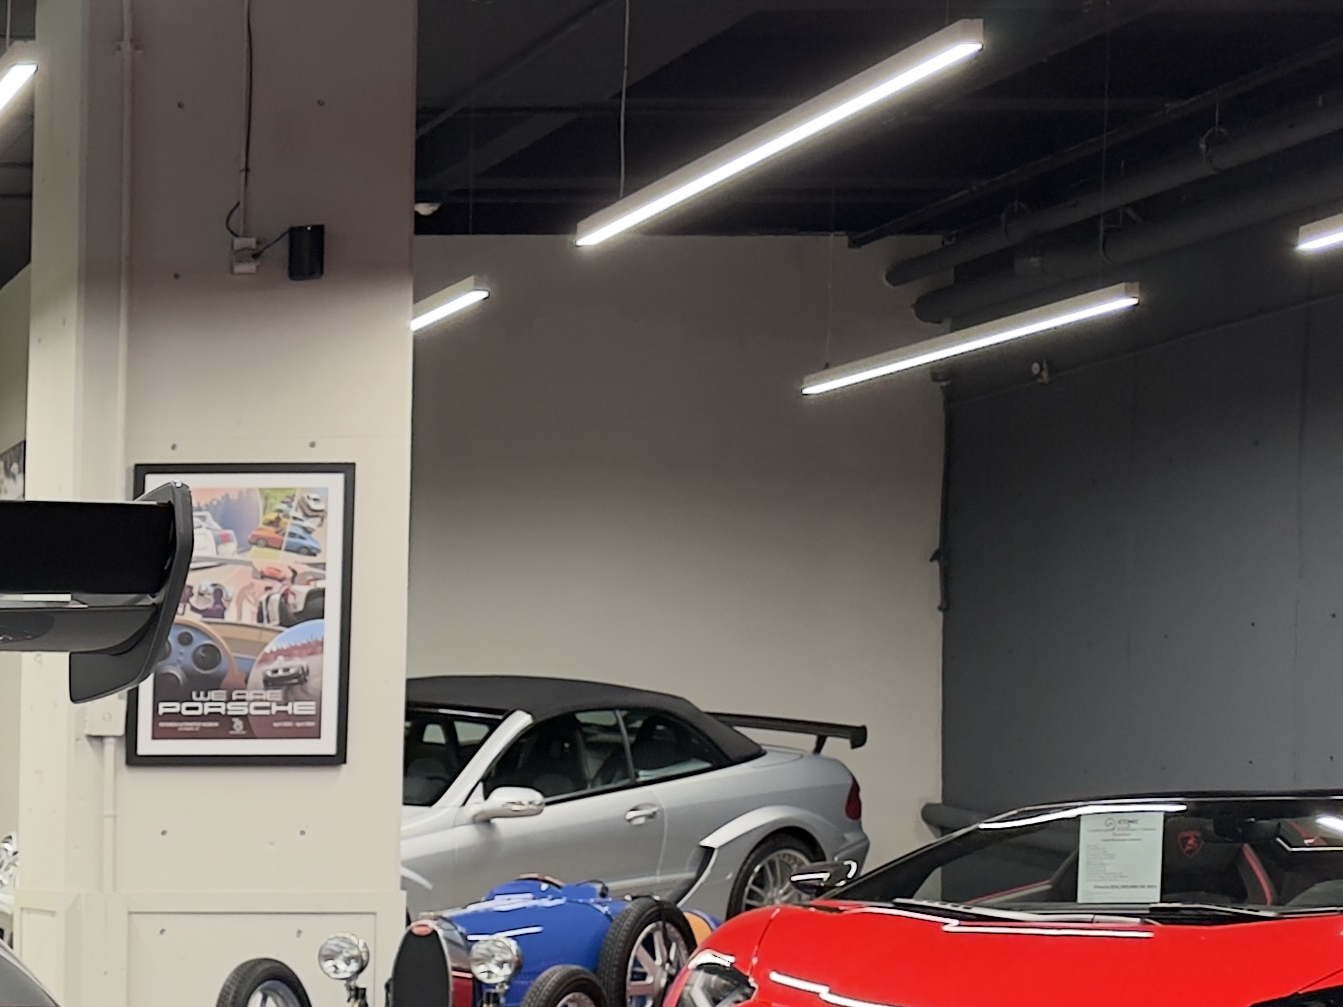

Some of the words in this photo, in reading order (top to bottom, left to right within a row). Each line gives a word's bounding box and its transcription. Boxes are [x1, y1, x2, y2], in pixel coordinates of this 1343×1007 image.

[192, 690, 227, 701] WE
[232, 690, 283, 701] ARE
[158, 701, 316, 715] PORSCHE
